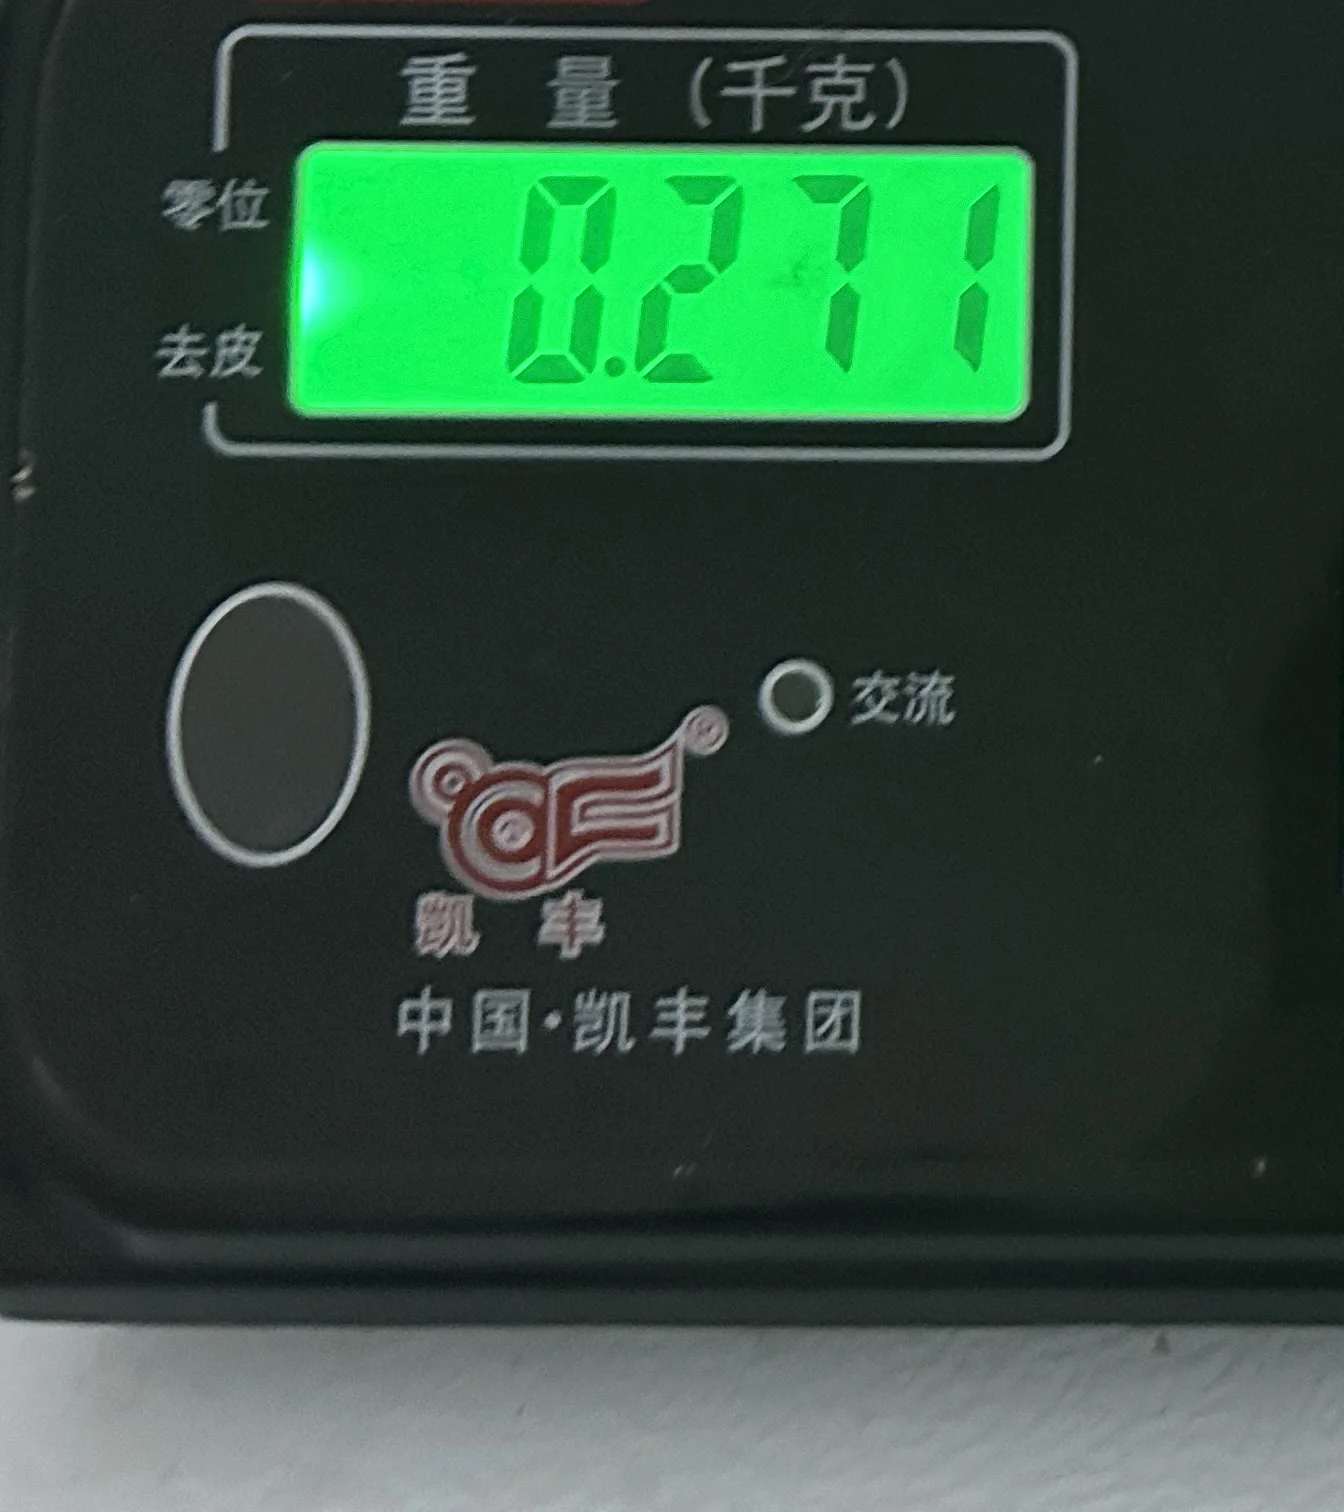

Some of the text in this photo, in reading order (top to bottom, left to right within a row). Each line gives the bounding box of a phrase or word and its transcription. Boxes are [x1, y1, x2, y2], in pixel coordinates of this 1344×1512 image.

[160, 178, 270, 231] 零位
[507, 175, 1000, 384] 0.271
[155, 322, 264, 379] 去皮
[850, 669, 957, 726] 交流
[415, 890, 607, 959] 凯丰
